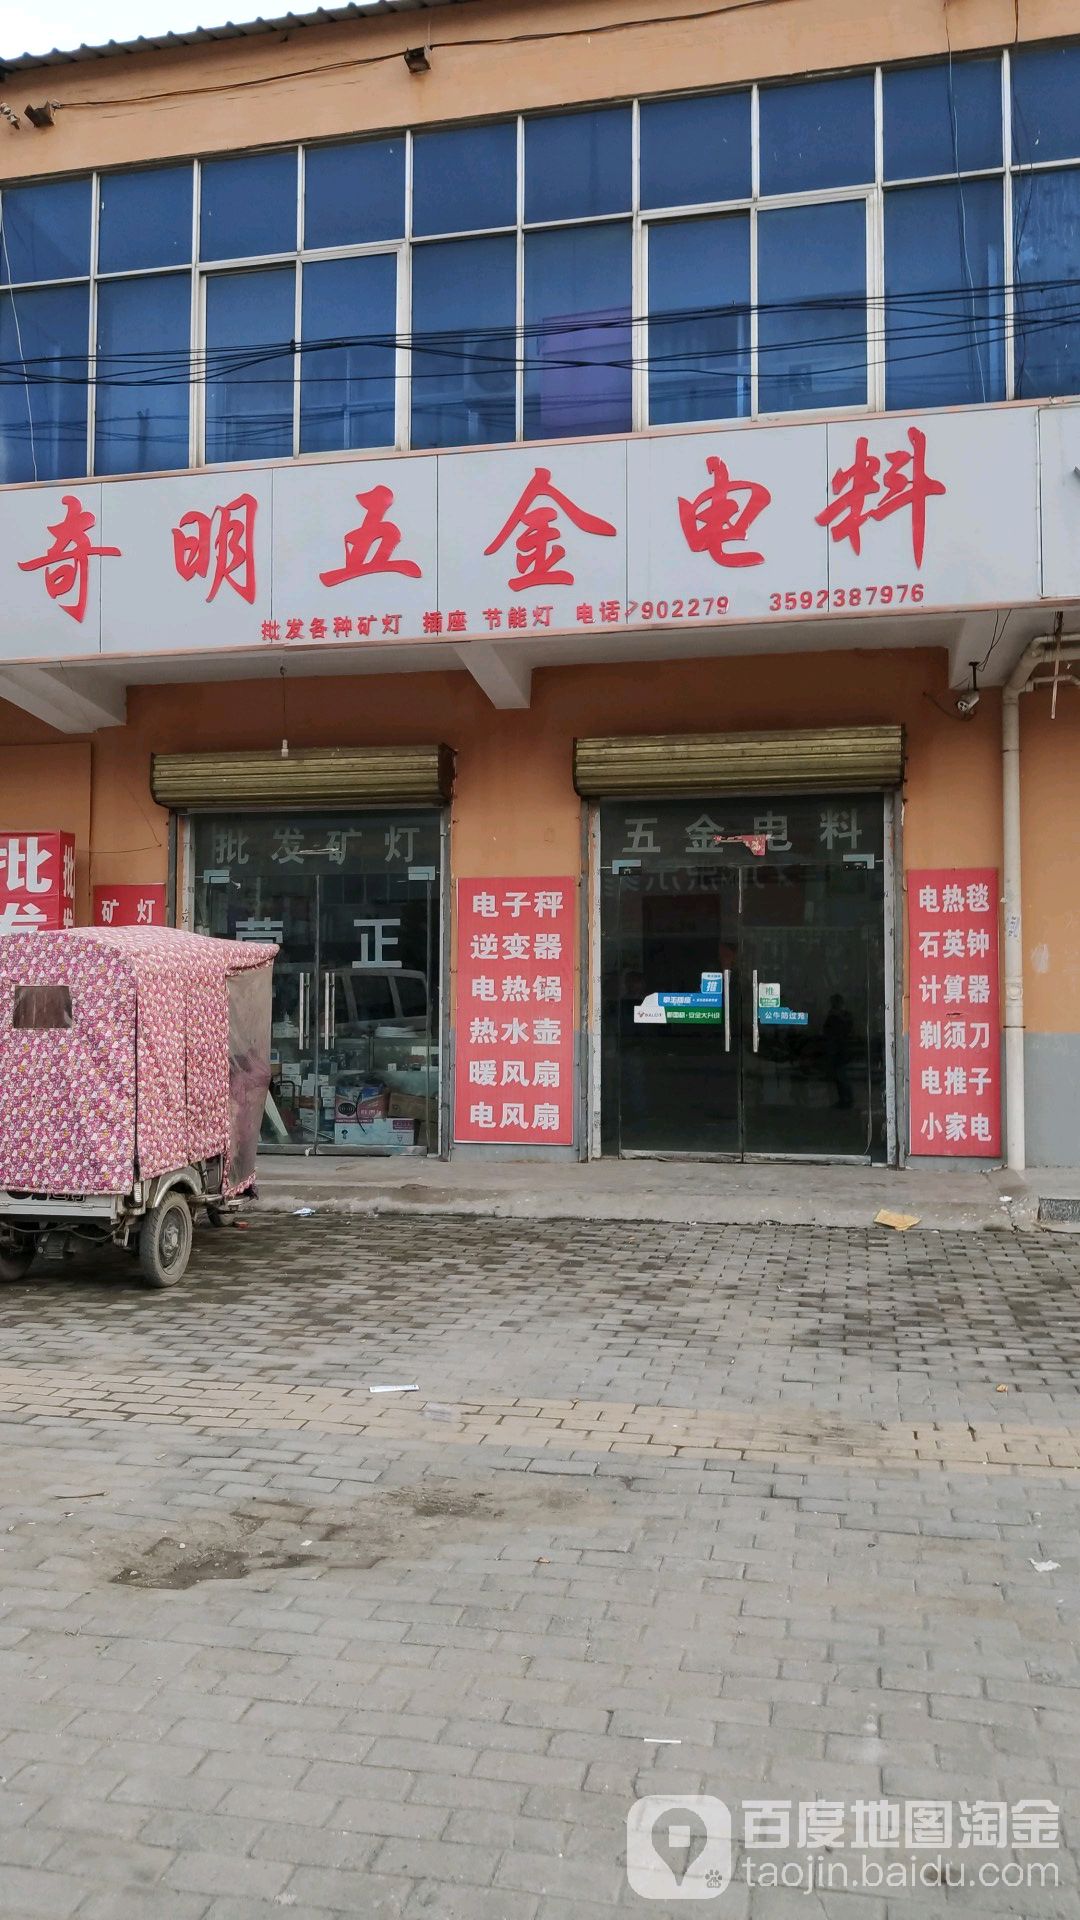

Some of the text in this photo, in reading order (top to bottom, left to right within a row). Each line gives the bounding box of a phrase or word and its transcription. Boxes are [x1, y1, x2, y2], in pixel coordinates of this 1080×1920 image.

[17, 426, 947, 623] 奇明五金电料
[261, 614, 402, 641] 批发各种矿灯
[423, 610, 467, 633] 插座
[482, 603, 554, 630] 节能灯
[769, 583, 924, 611] 3592387976
[212, 825, 421, 866] 批发矿灯
[622, 808, 863, 854] 五金电料
[101, 898, 156, 924] 矿灯
[472, 891, 564, 918] 电子秤
[919, 883, 990, 913] 电热毯
[470, 933, 563, 961] 逆变器
[918, 929, 990, 959] 石英钟
[471, 975, 562, 1003] 电热锅
[918, 975, 991, 1005] 计算器
[469, 1016, 562, 1045] 热水壶
[919, 1020, 990, 1050] 剃须刀
[468, 1058, 561, 1088] 暖风扇
[921, 1066, 992, 1096] 电推子
[469, 1100, 560, 1131] 电风扇
[920, 1111, 992, 1142] 小家电
